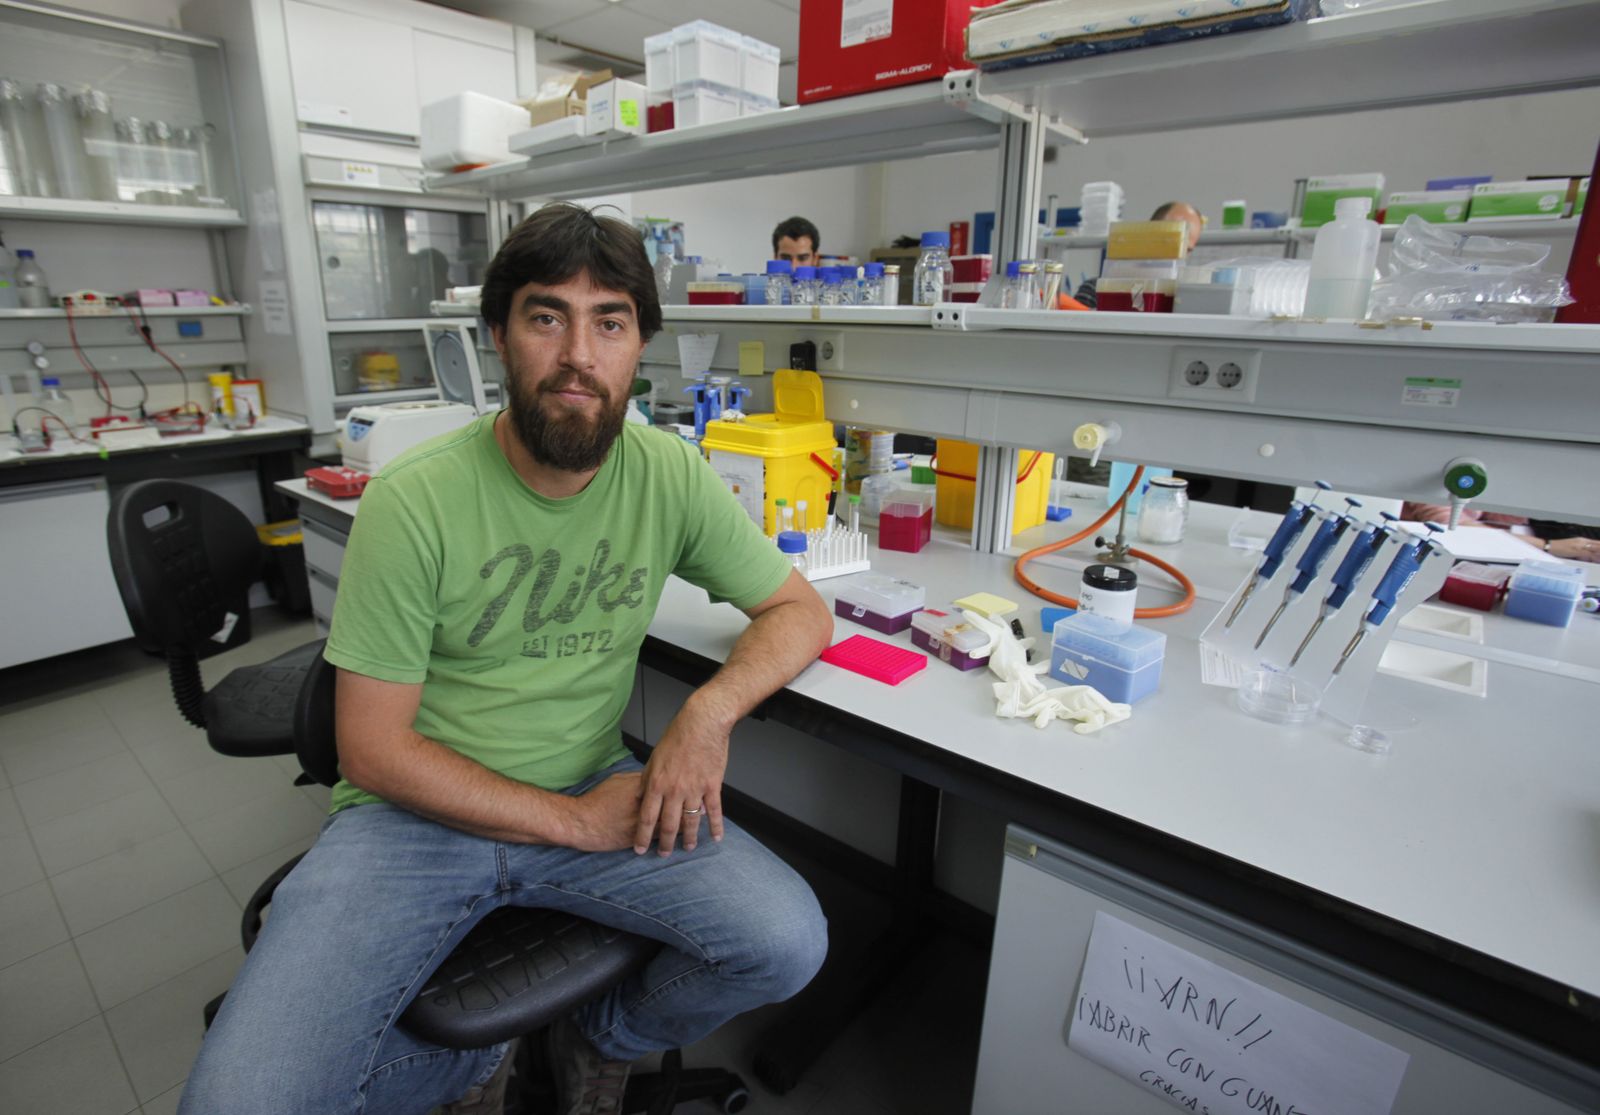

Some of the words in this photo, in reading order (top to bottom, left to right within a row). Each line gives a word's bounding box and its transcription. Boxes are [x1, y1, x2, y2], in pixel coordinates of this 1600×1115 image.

[875, 63, 932, 81] SIGMA-ALDRICH
[467, 538, 648, 648] Nike
[556, 628, 614, 658] 1972
[1166, 1048, 1215, 1082] CON
[1220, 1077, 1309, 1115] GUAN
